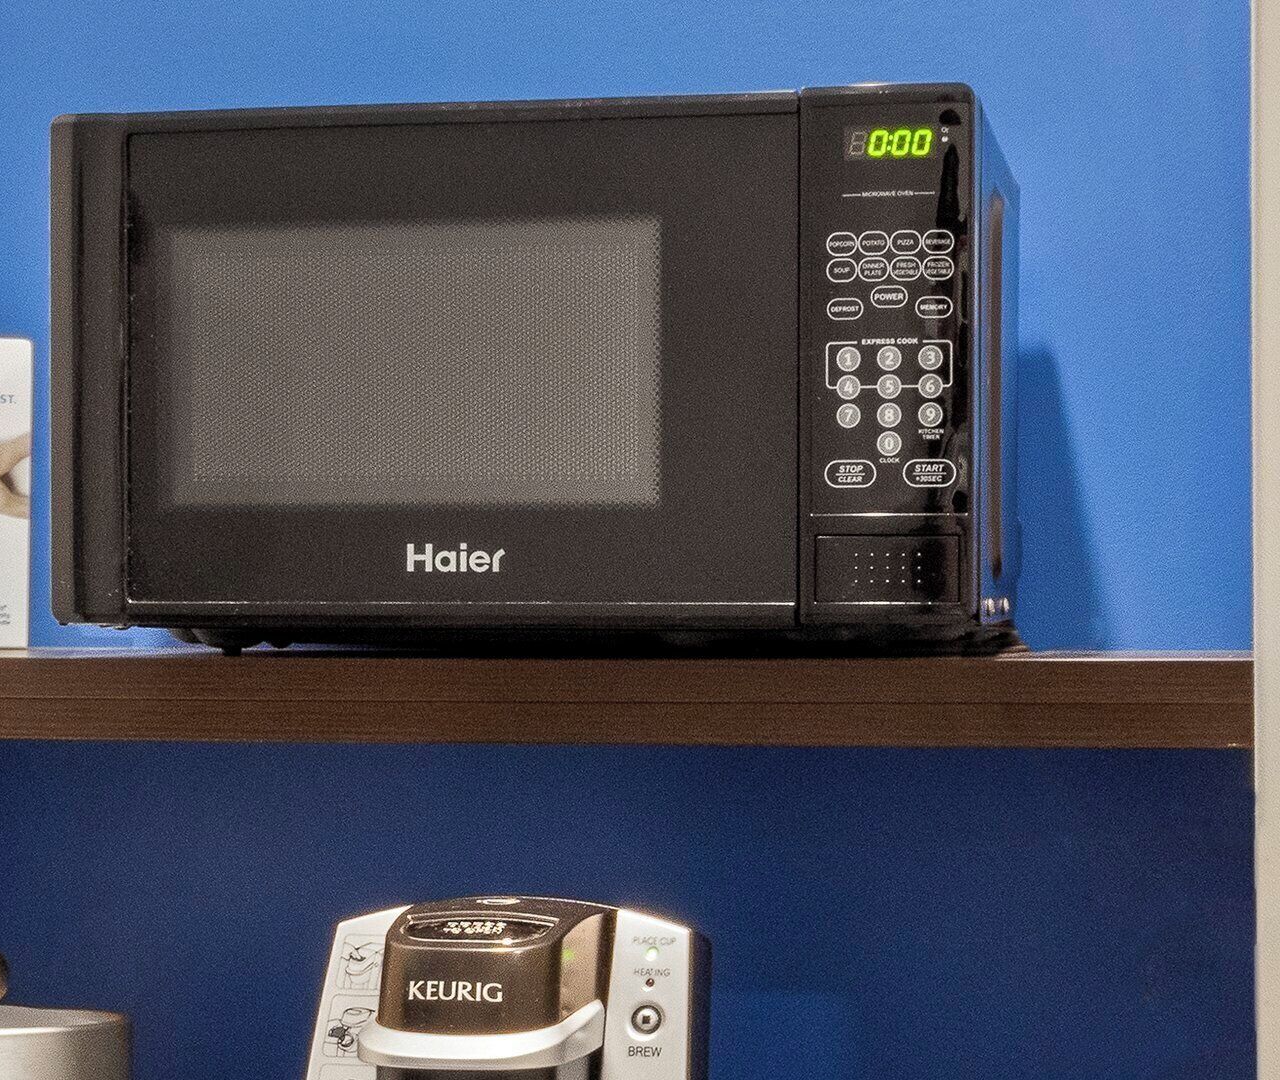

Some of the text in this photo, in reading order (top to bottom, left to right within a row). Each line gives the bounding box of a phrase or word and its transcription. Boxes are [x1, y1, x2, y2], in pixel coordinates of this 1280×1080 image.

[829, 240, 855, 248] POPCORN
[862, 239, 886, 247] POTATO
[896, 238, 915, 246] PIZZA
[833, 266, 851, 274] SOUP
[874, 293, 904, 301] POWER
[830, 305, 860, 313] DEFROST
[920, 303, 948, 311] MEMORY
[896, 337, 919, 345] COOK
[843, 353, 852, 366] 1
[885, 352, 894, 365] 2
[926, 351, 936, 365] 3
[843, 380, 853, 394] 4
[885, 380, 894, 393] 5
[925, 380, 935, 393] 6
[844, 409, 853, 422] 7
[884, 409, 894, 422] 8
[925, 408, 936, 421] 9
[885, 438, 894, 450] 0
[839, 465, 864, 473] STOP
[914, 464, 945, 473] START
[406, 542, 506, 573] Haier
[632, 936, 677, 946] PLACE CUP
[633, 967, 671, 977] HEATING
[408, 980, 503, 1003] KEURIG
[628, 1045, 662, 1058] BREW
